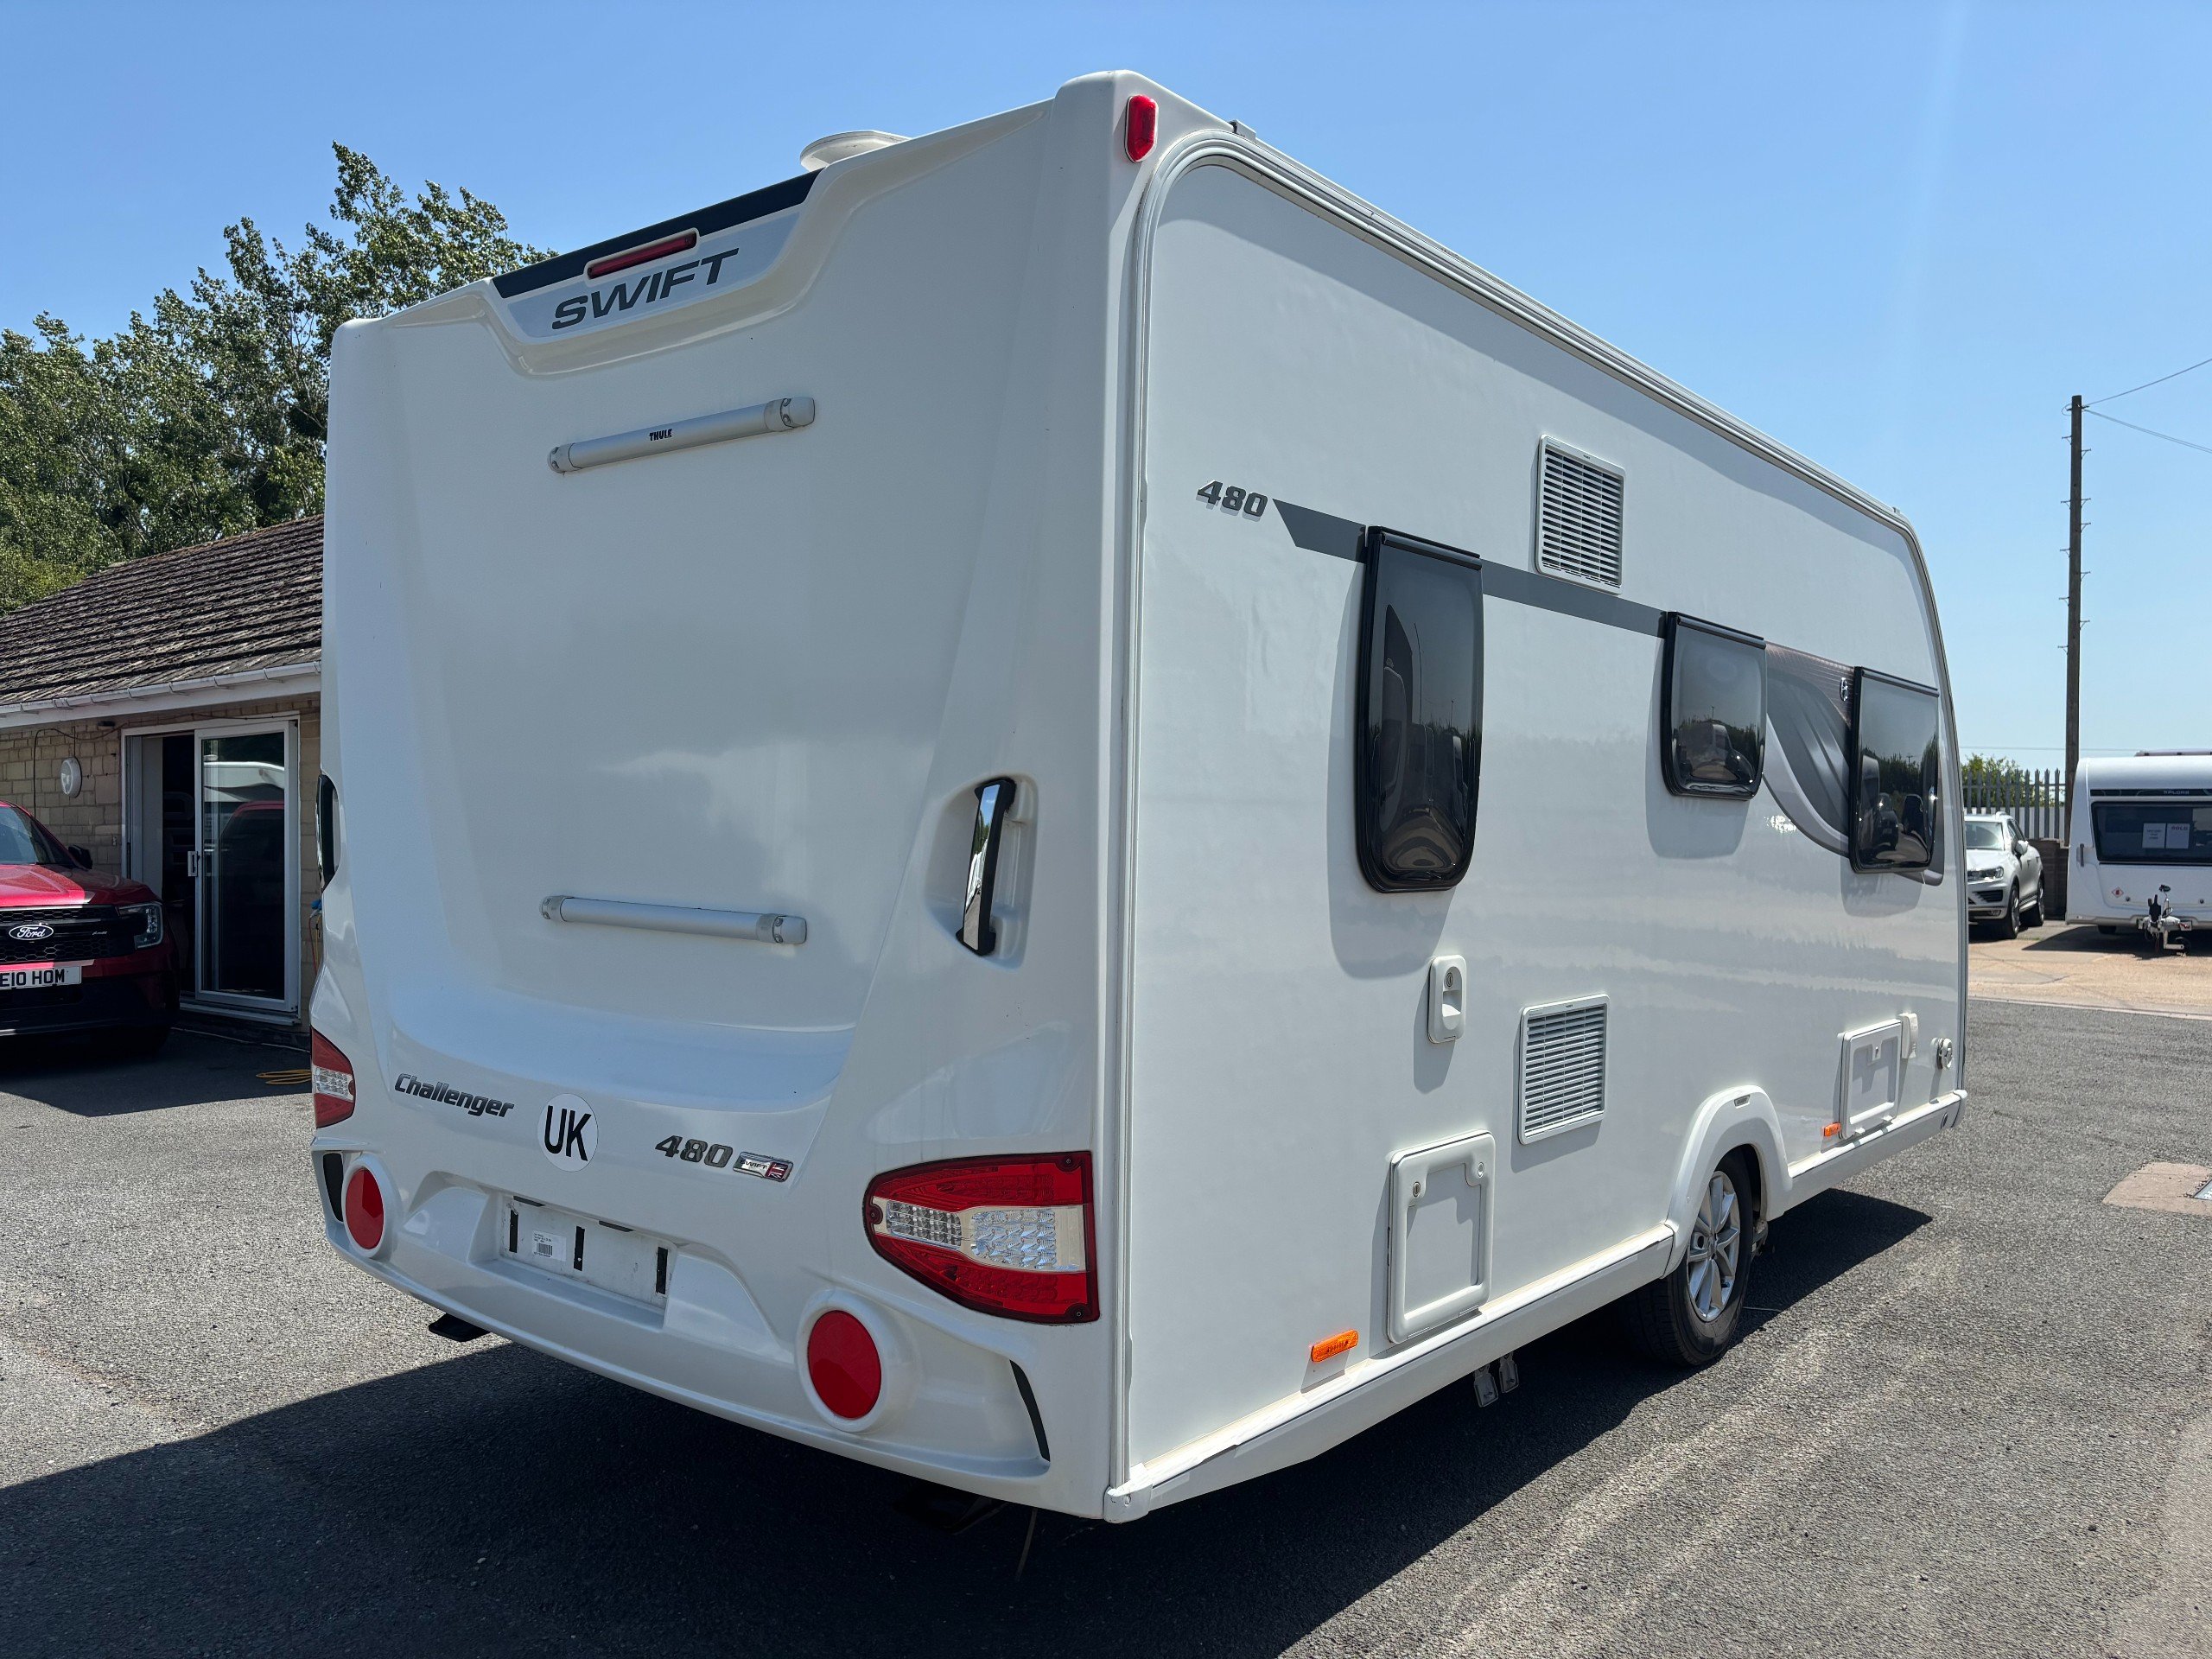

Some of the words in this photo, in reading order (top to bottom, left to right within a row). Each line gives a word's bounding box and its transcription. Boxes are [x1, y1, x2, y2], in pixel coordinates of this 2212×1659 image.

[551, 247, 740, 330] SWIFT
[649, 428, 672, 442] THULE
[1197, 480, 1268, 518] 480
[16, 926, 46, 938] Ford
[32, 969, 65, 984] HOM
[394, 1073, 515, 1118] Challenger
[543, 1105, 592, 1162] UK
[655, 1135, 734, 1169] 480
[740, 1158, 768, 1170] SWIFT
